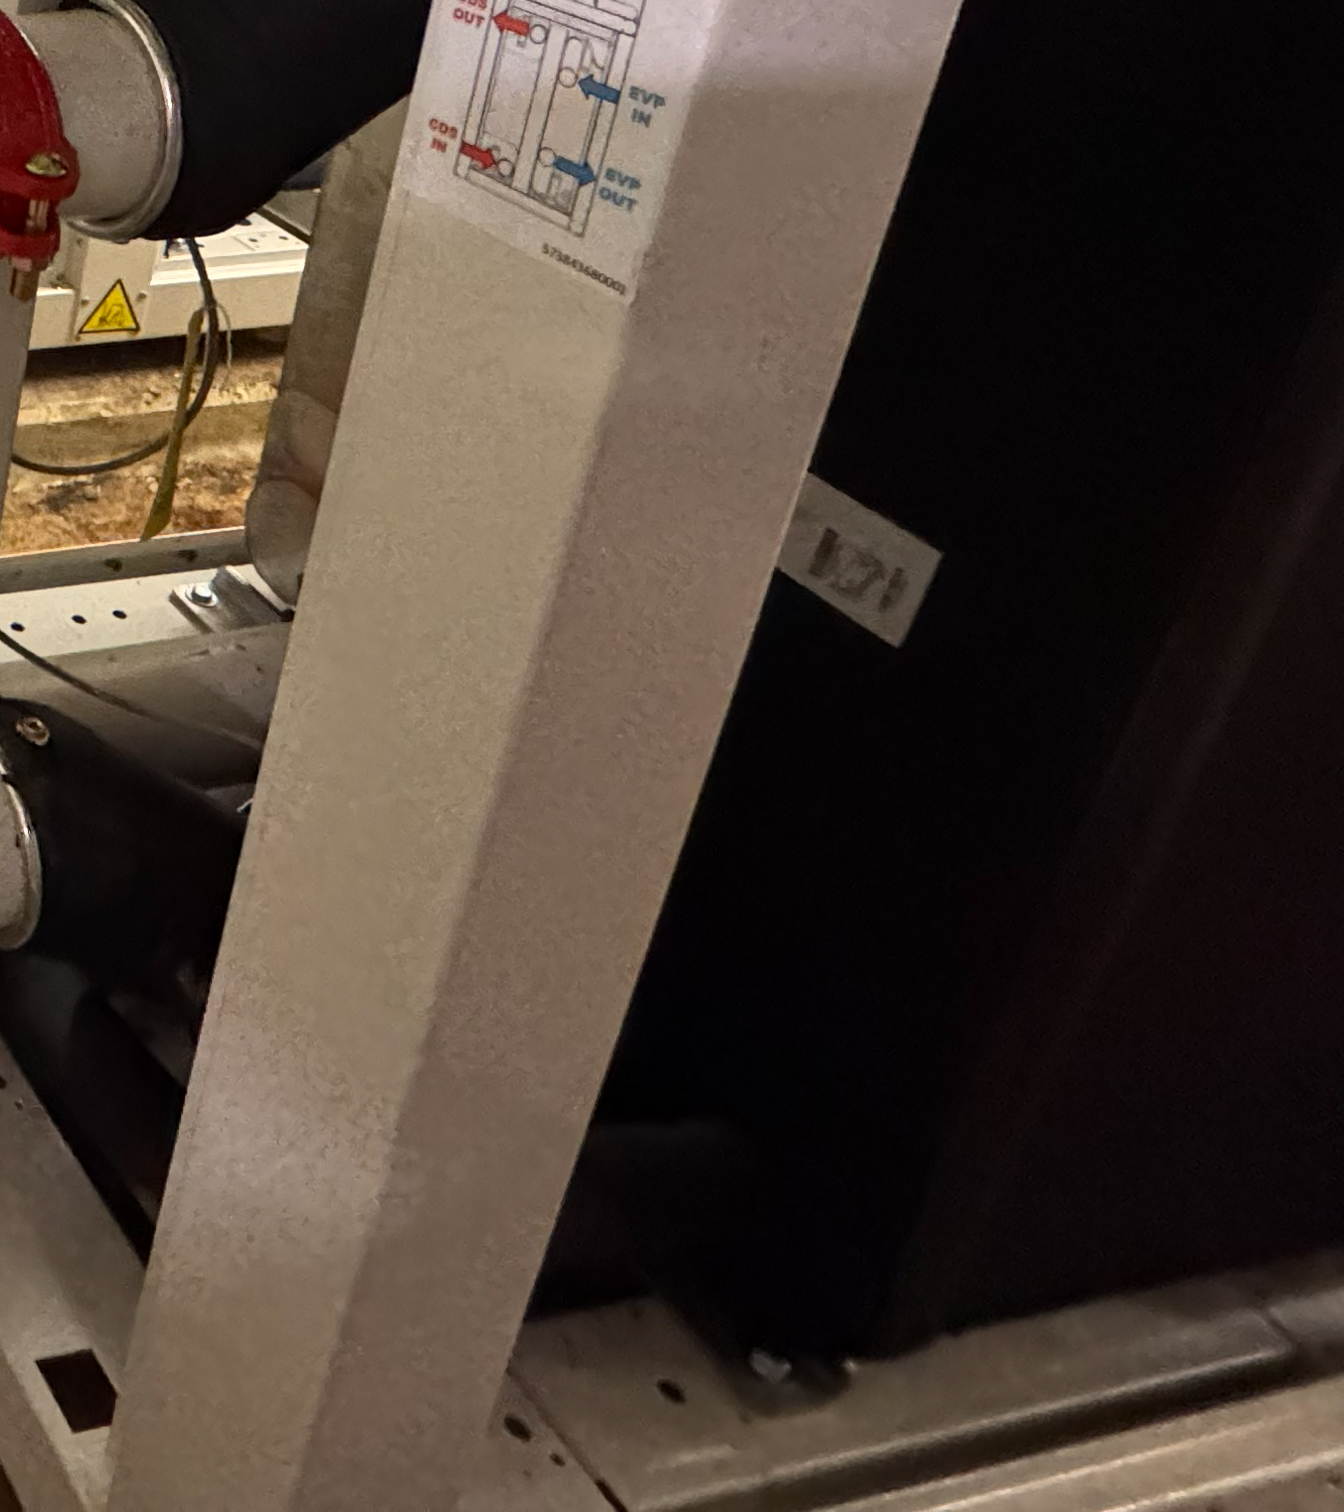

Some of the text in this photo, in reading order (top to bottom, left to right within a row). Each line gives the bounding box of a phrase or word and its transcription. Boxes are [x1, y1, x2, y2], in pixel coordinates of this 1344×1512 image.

[453, 8, 485, 28] OUT
[629, 85, 667, 109] EVP
[429, 118, 458, 140] CDS
[631, 108, 652, 128] IN
[430, 138, 448, 153] IN
[605, 168, 642, 190] EVP
[598, 187, 639, 213] OUT
